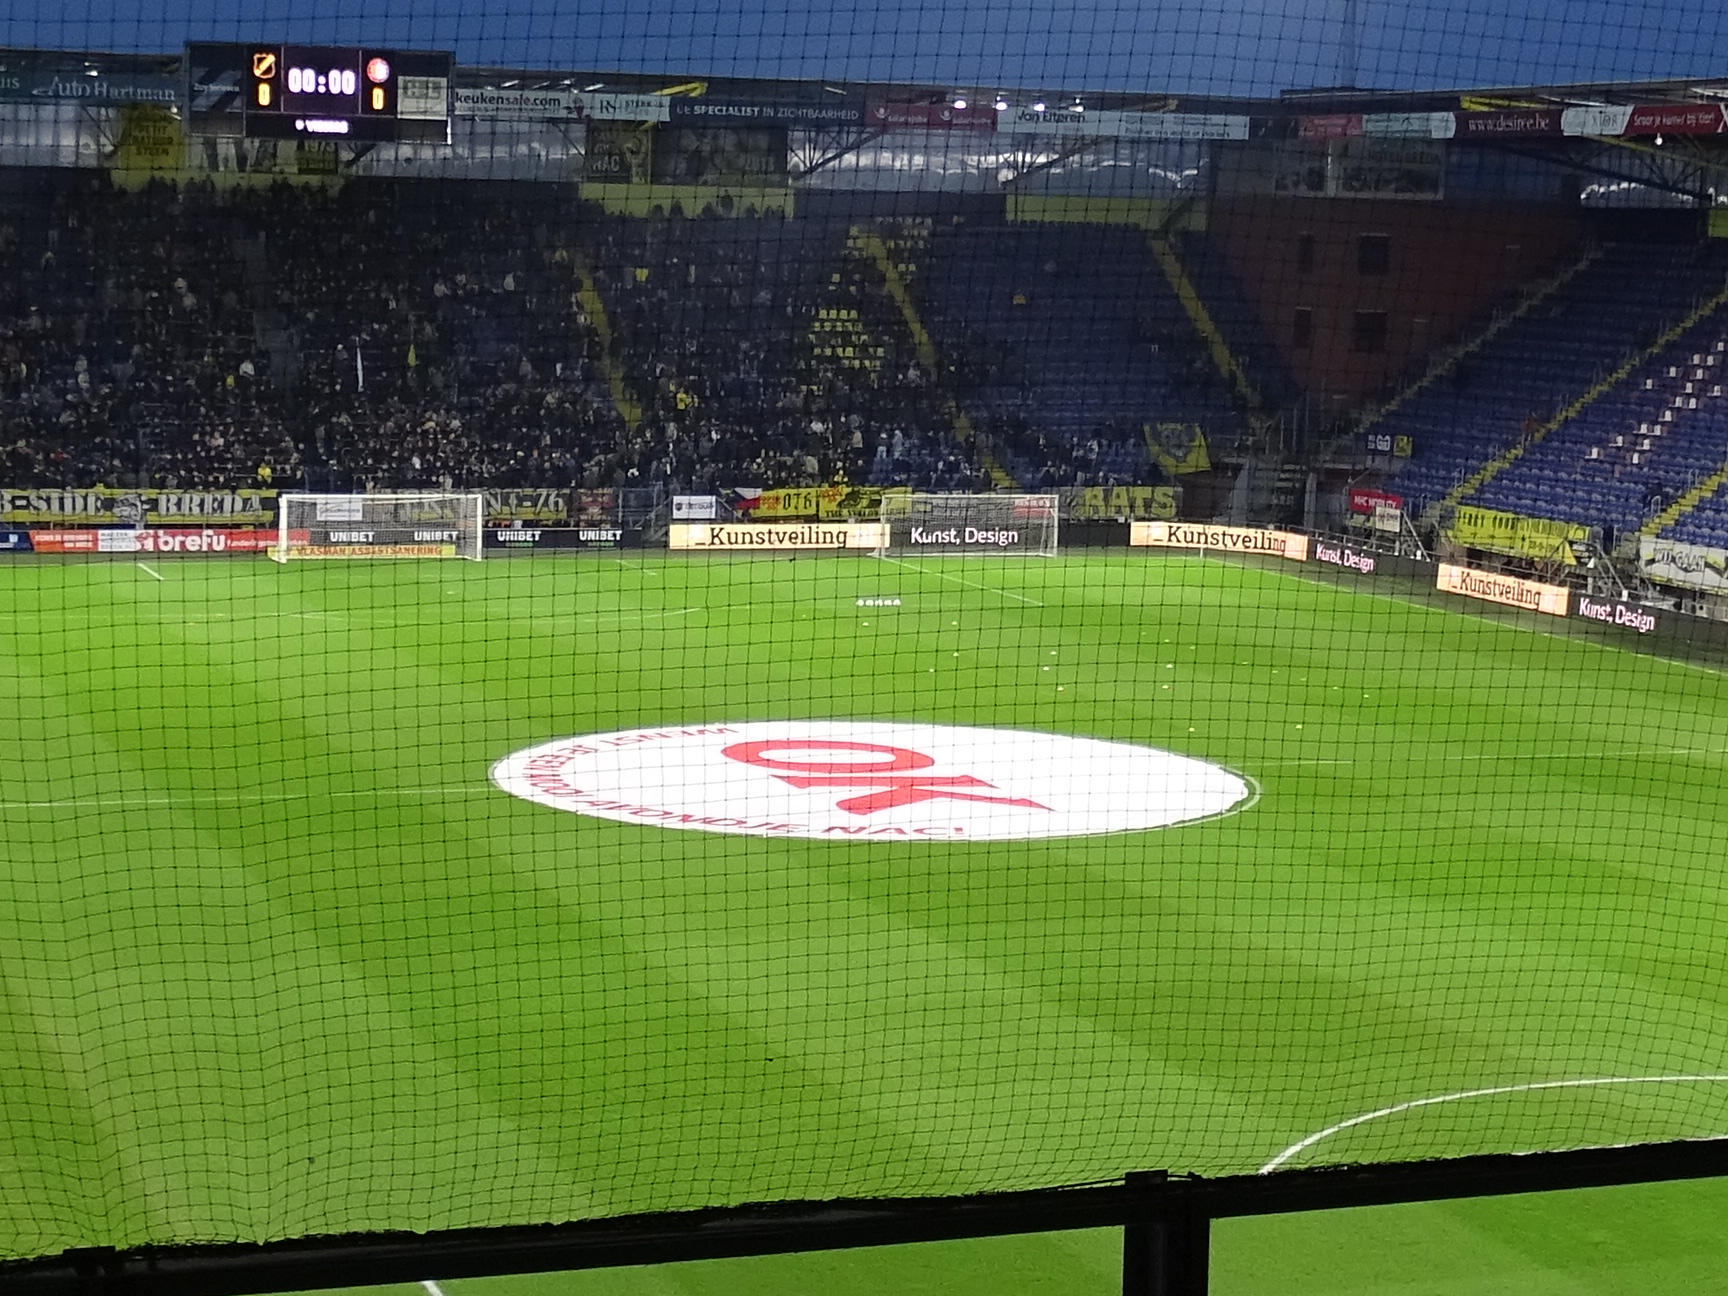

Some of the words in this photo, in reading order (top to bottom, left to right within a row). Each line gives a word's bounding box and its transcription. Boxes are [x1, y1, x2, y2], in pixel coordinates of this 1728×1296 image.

[288, 67, 356, 95] 00:00
[93, 80, 177, 103] Hartman
[258, 83, 270, 106] 0
[372, 87, 384, 110] 0
[455, 90, 561, 108] keukensale.com
[693, 105, 760, 118] SPECIALIST
[762, 106, 775, 118] IN
[777, 106, 859, 121] ZICHTBAARHEID
[156, 491, 263, 515] BREDA
[157, 530, 226, 552] brefu
[329, 531, 375, 543] UNIBET
[413, 530, 459, 542] UNIBET
[497, 530, 542, 542] UNIBET
[579, 530, 623, 541] UNIBET
[910, 527, 961, 546] Kunst,
[964, 527, 1019, 546] Design
[1316, 542, 1343, 566] Kunst,
[1343, 549, 1375, 573] Design
[1579, 597, 1613, 624] Kunst,
[1615, 604, 1656, 633] Design
[720, 738, 1057, 816] OK
[821, 825, 966, 836] NAC!
